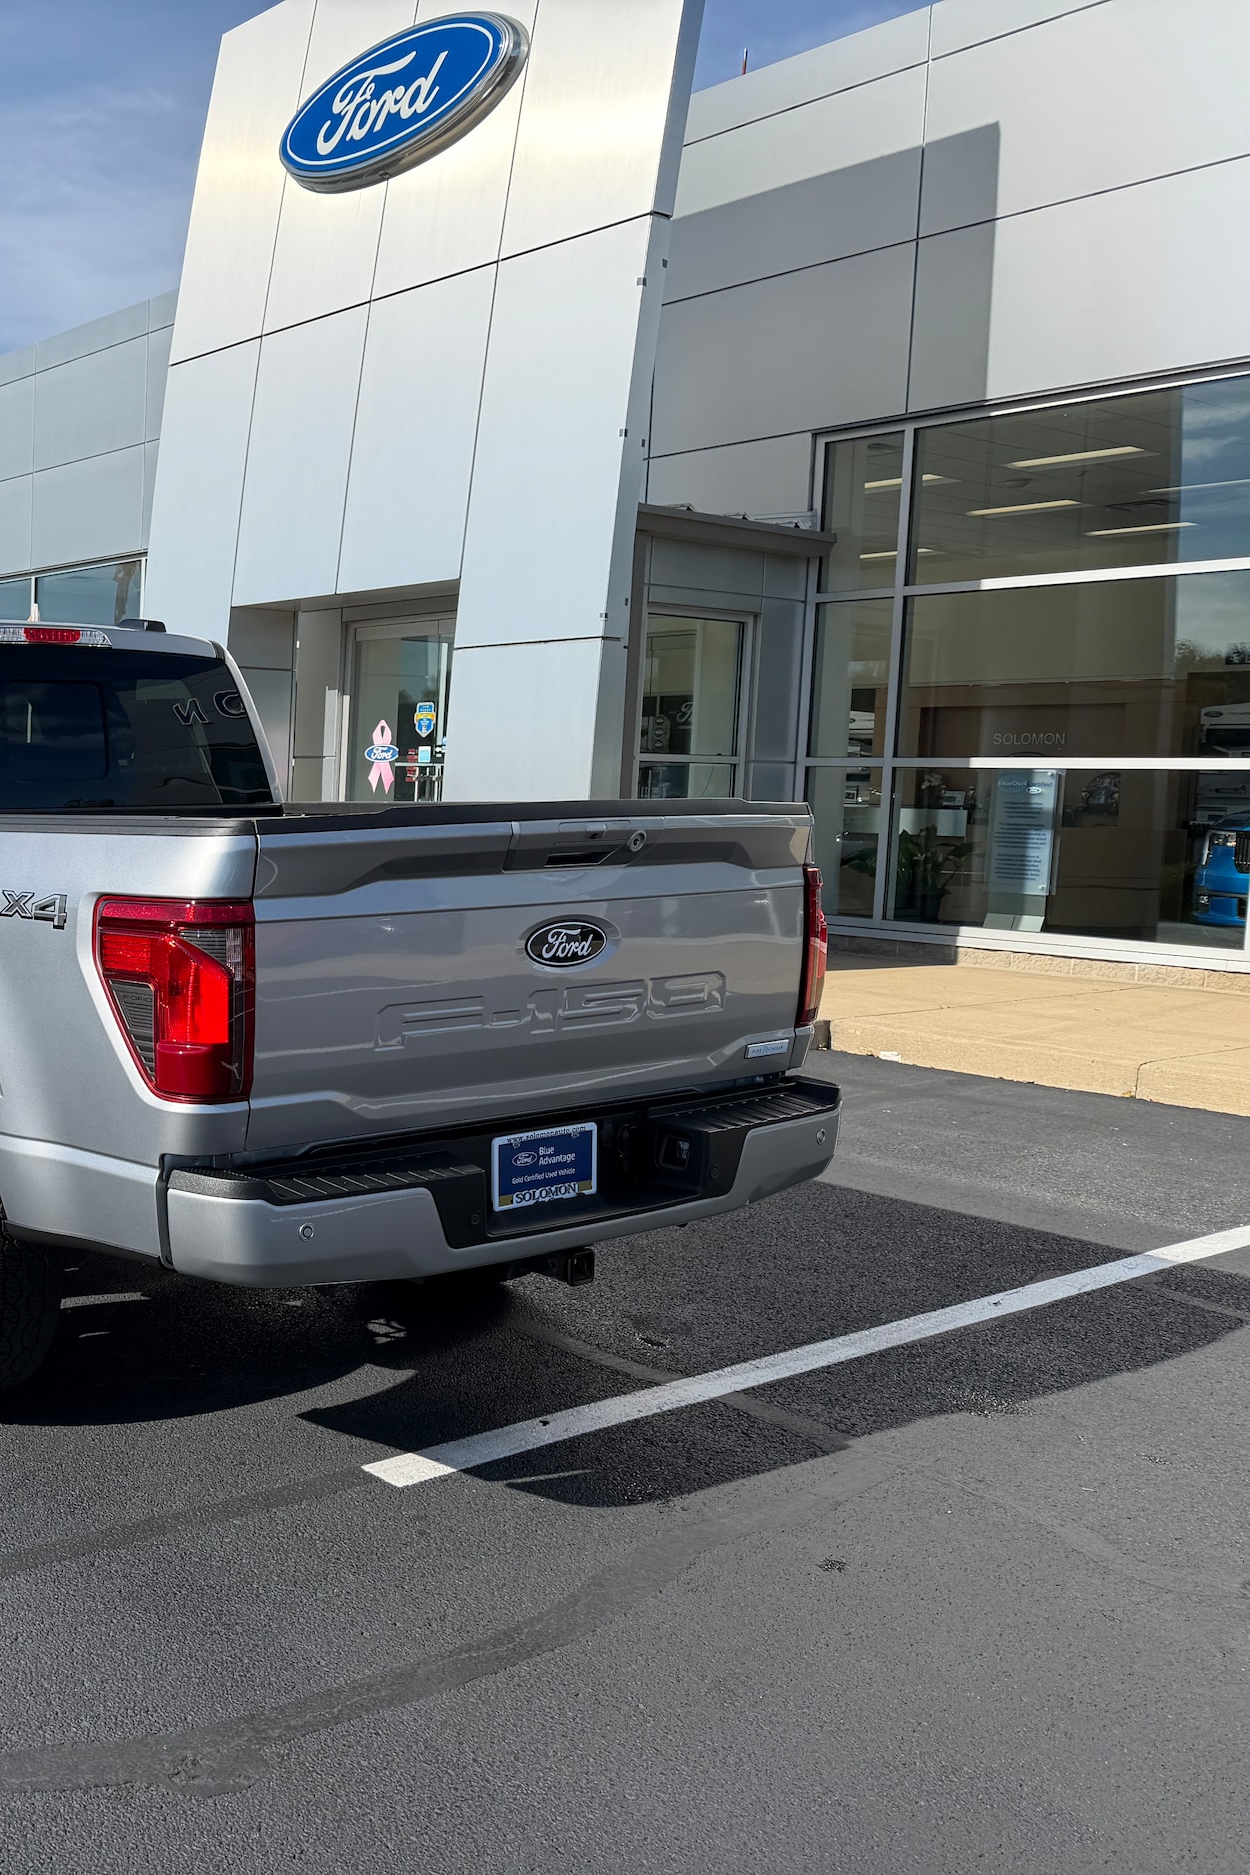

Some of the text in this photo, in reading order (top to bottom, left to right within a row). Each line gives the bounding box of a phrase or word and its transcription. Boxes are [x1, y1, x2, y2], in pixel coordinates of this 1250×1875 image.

[316, 50, 448, 156] Ford
[993, 733, 1066, 745] SOLOMON
[370, 746, 394, 760] Ford
[541, 928, 594, 959] Ford
[374, 970, 727, 1051] F-150
[538, 1146, 555, 1155] Blue
[516, 1153, 576, 1166] Ford Advantage
[511, 1168, 576, 1184] Gold Certified Used Vehicle
[515, 1183, 577, 1204] SOLOMON
